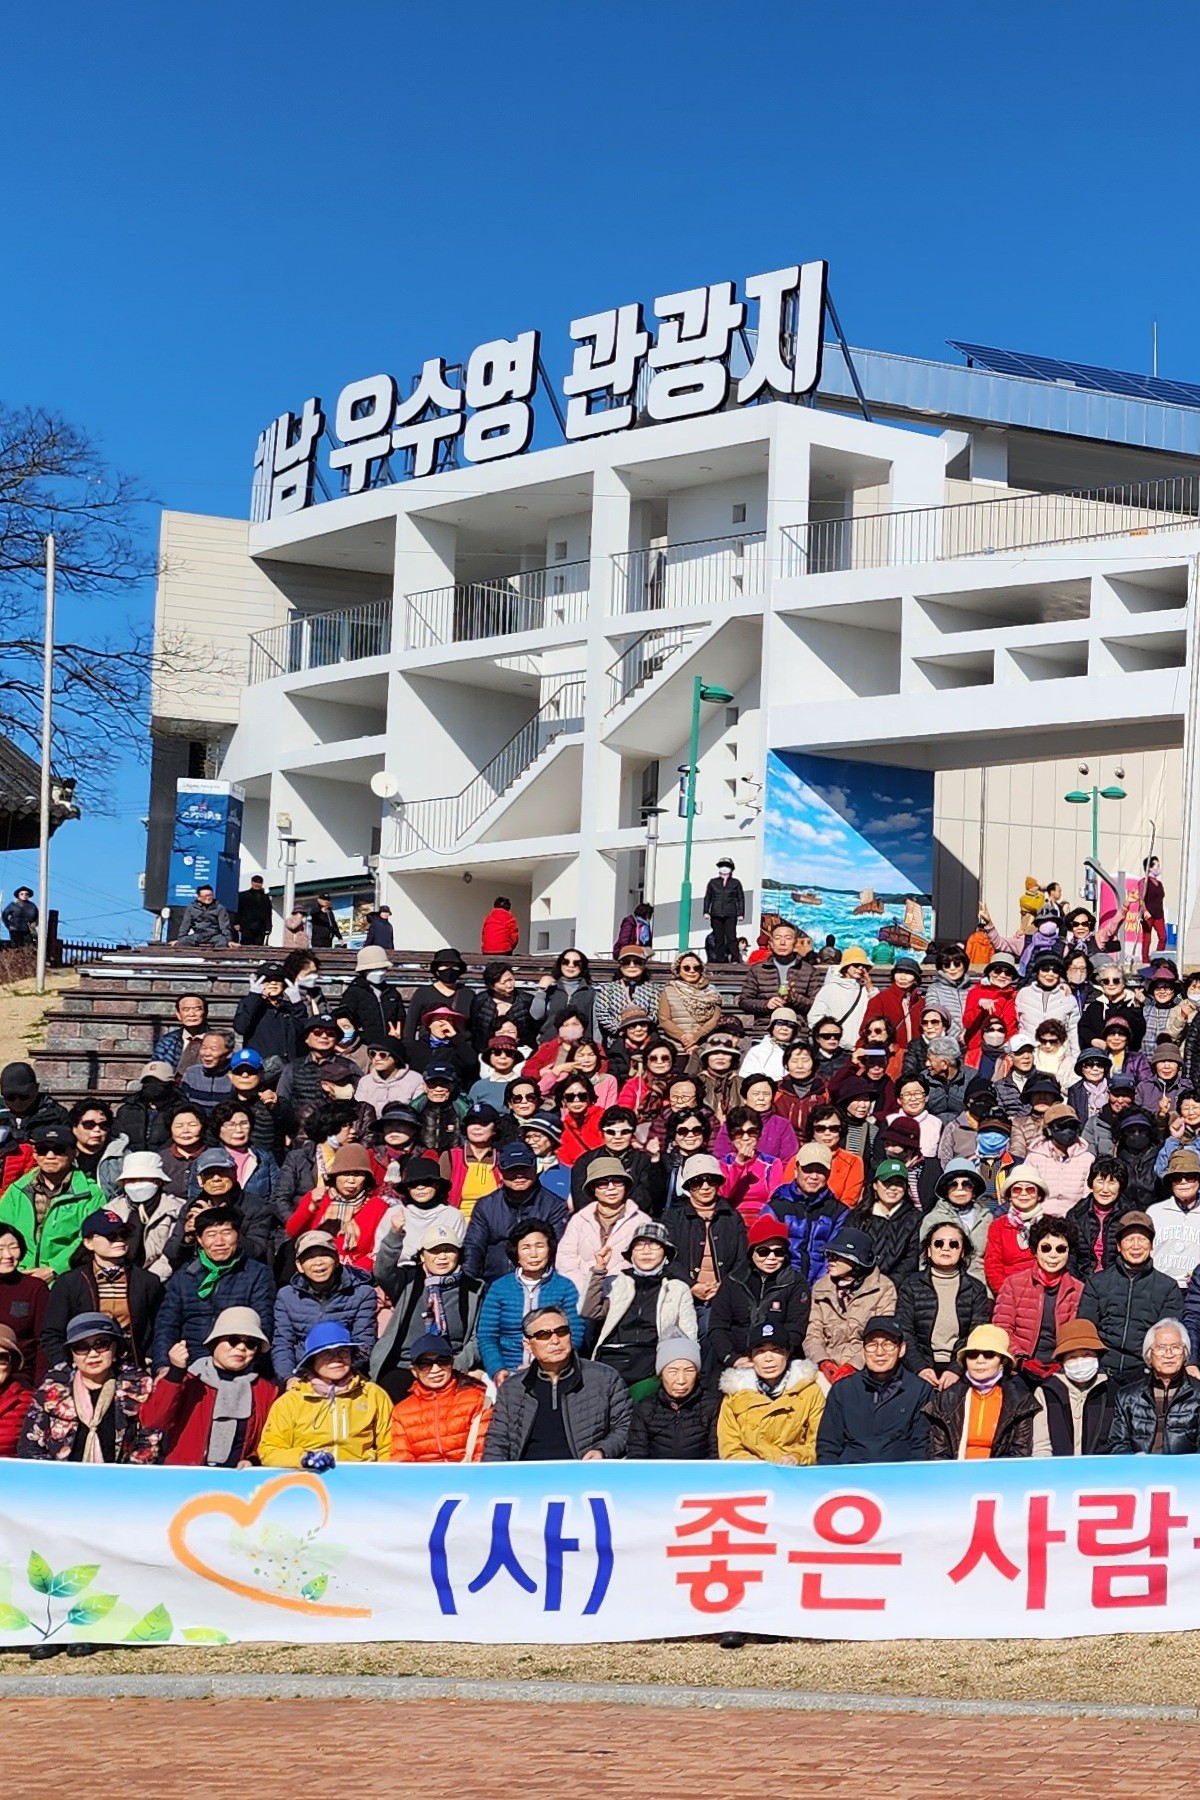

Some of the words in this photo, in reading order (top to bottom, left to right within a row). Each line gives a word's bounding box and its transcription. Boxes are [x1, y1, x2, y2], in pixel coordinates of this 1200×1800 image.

[250, 397, 325, 522] 해남
[329, 330, 540, 494] 우수영
[563, 260, 828, 439] 관광지
[429, 1498, 614, 1615] (사)
[665, 1495, 903, 1615] 좋은
